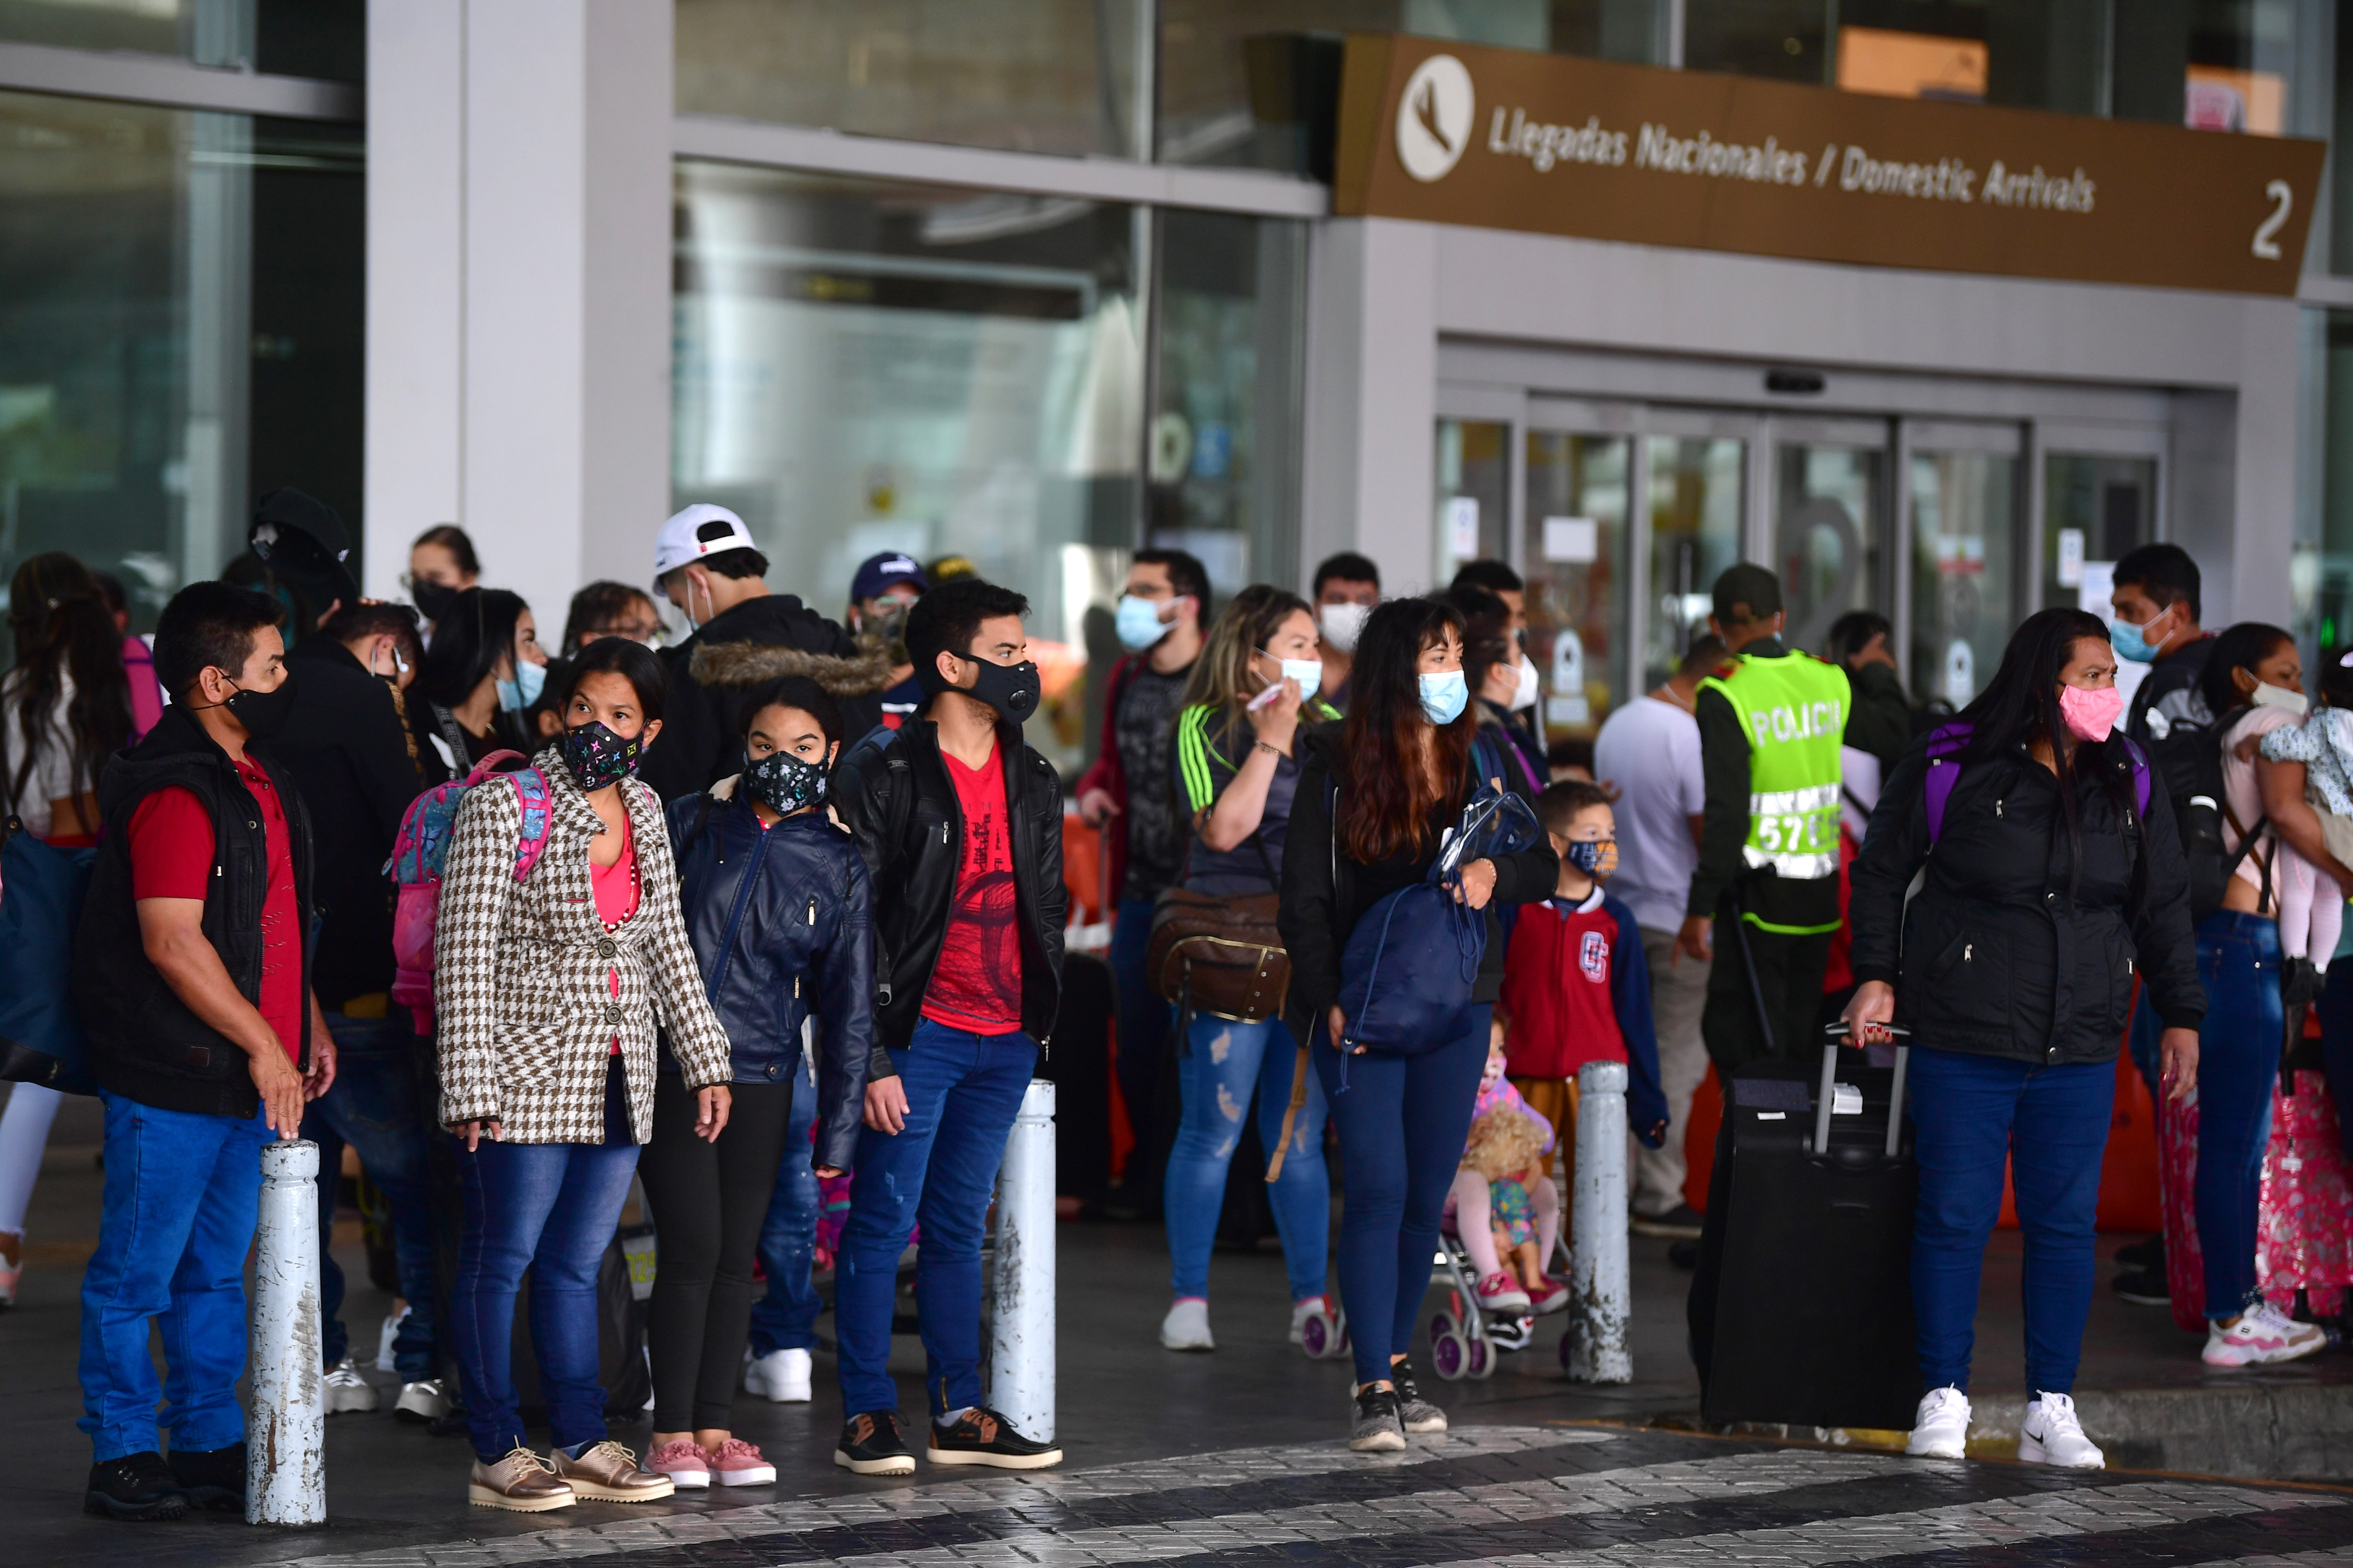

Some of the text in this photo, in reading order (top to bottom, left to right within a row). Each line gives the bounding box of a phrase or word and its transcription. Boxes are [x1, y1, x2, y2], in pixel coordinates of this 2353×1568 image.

[1489, 106, 2095, 212] Llegadas Nacionales / Domestic Arrivals
[2251, 179, 2293, 259] 2
